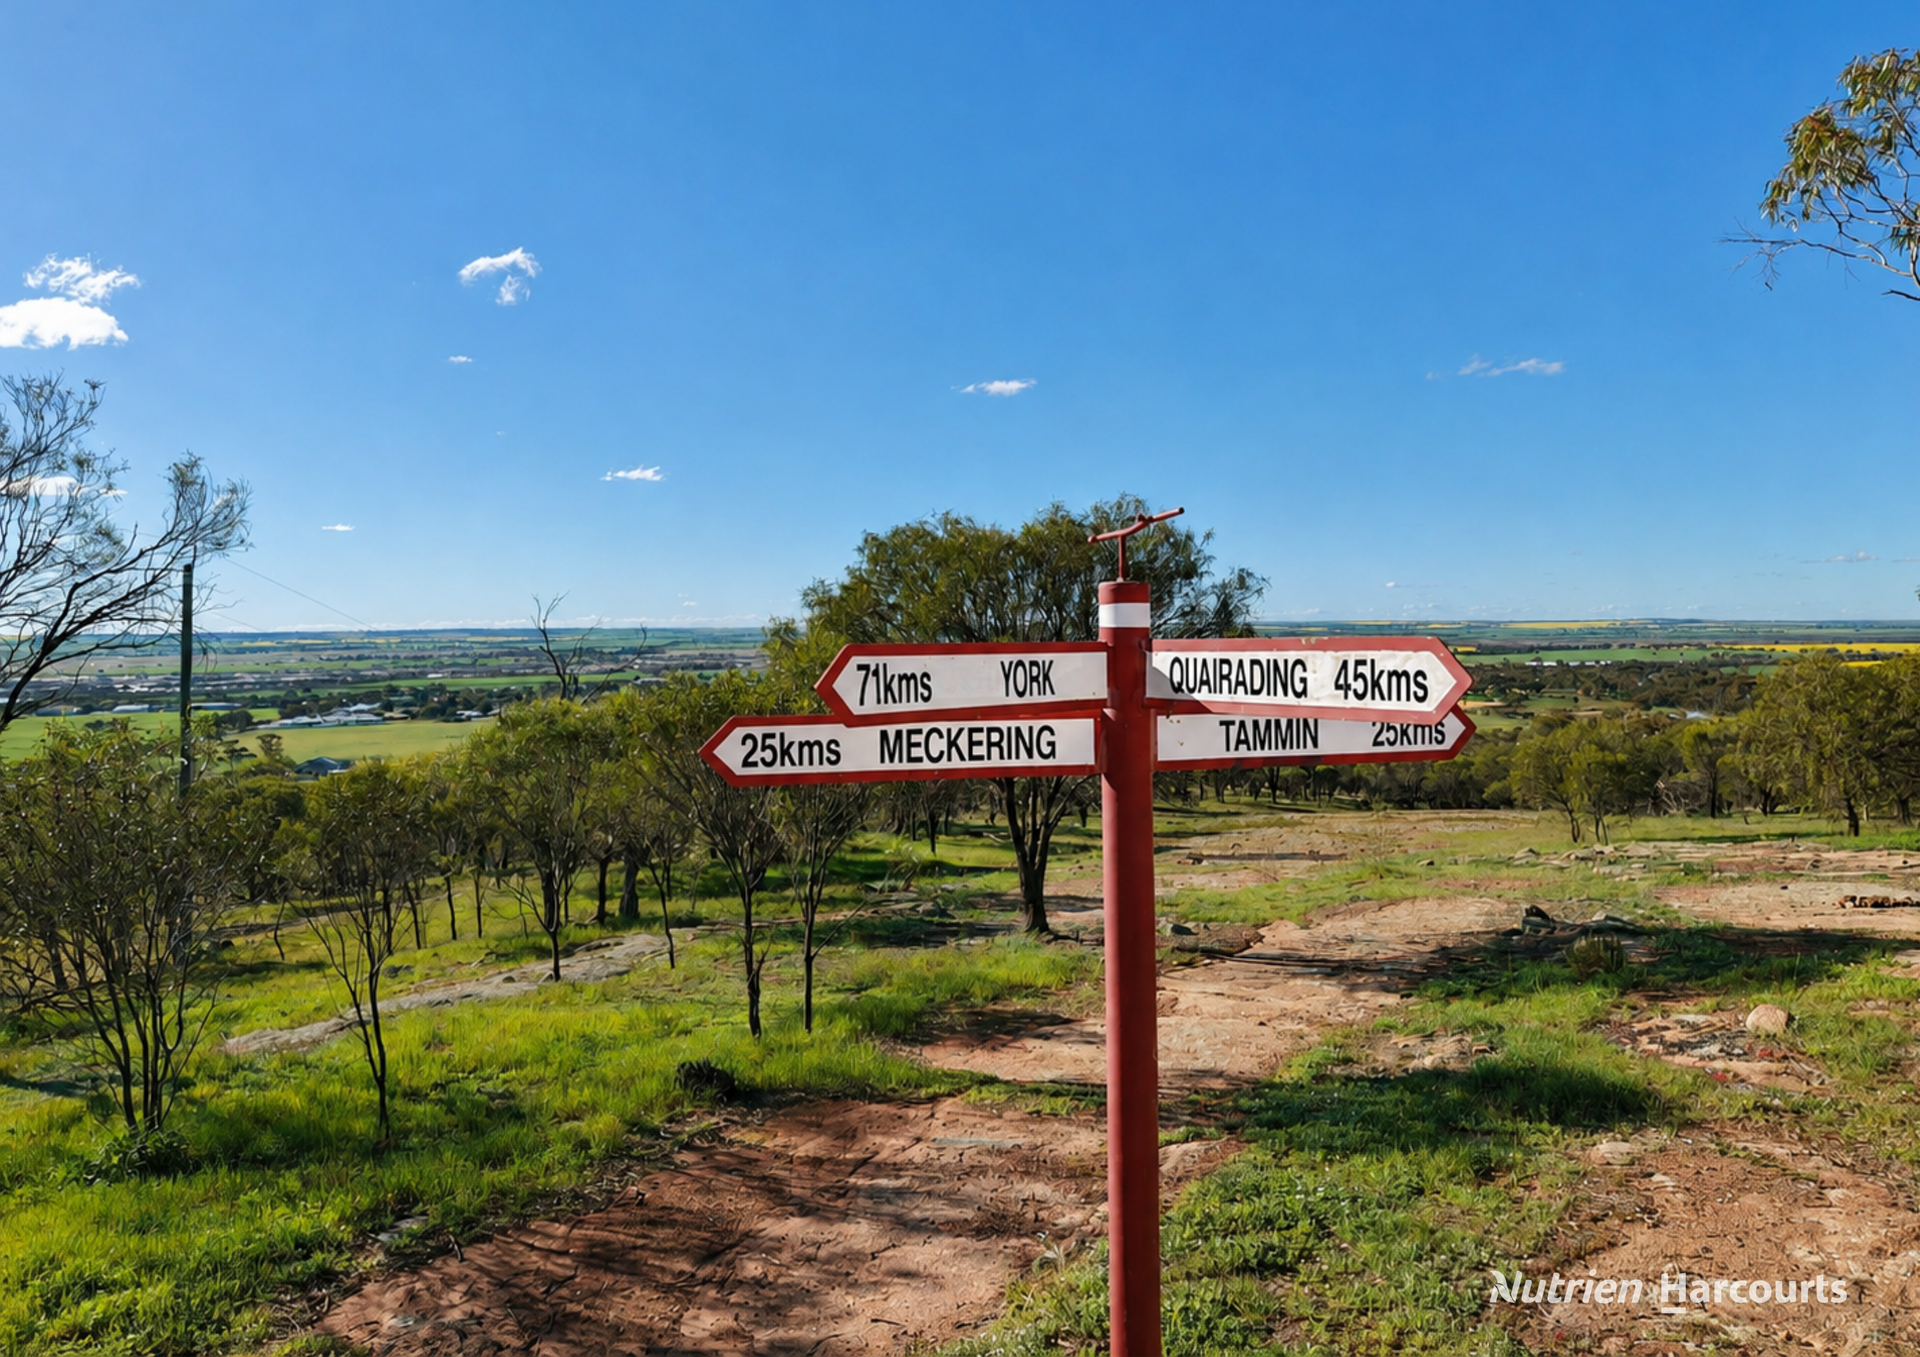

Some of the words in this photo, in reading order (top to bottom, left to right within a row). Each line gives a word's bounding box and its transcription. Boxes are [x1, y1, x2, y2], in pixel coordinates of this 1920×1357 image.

[856, 663, 932, 706] 71kms
[1000, 660, 1055, 698] YORK
[1169, 656, 1308, 698] QUAIRADING
[1334, 659, 1429, 703] 45kms
[741, 732, 841, 768] 25kms
[879, 725, 1056, 764] MECKERING
[1219, 718, 1319, 752] TAMMIN
[1371, 721, 1446, 747] 25kms
